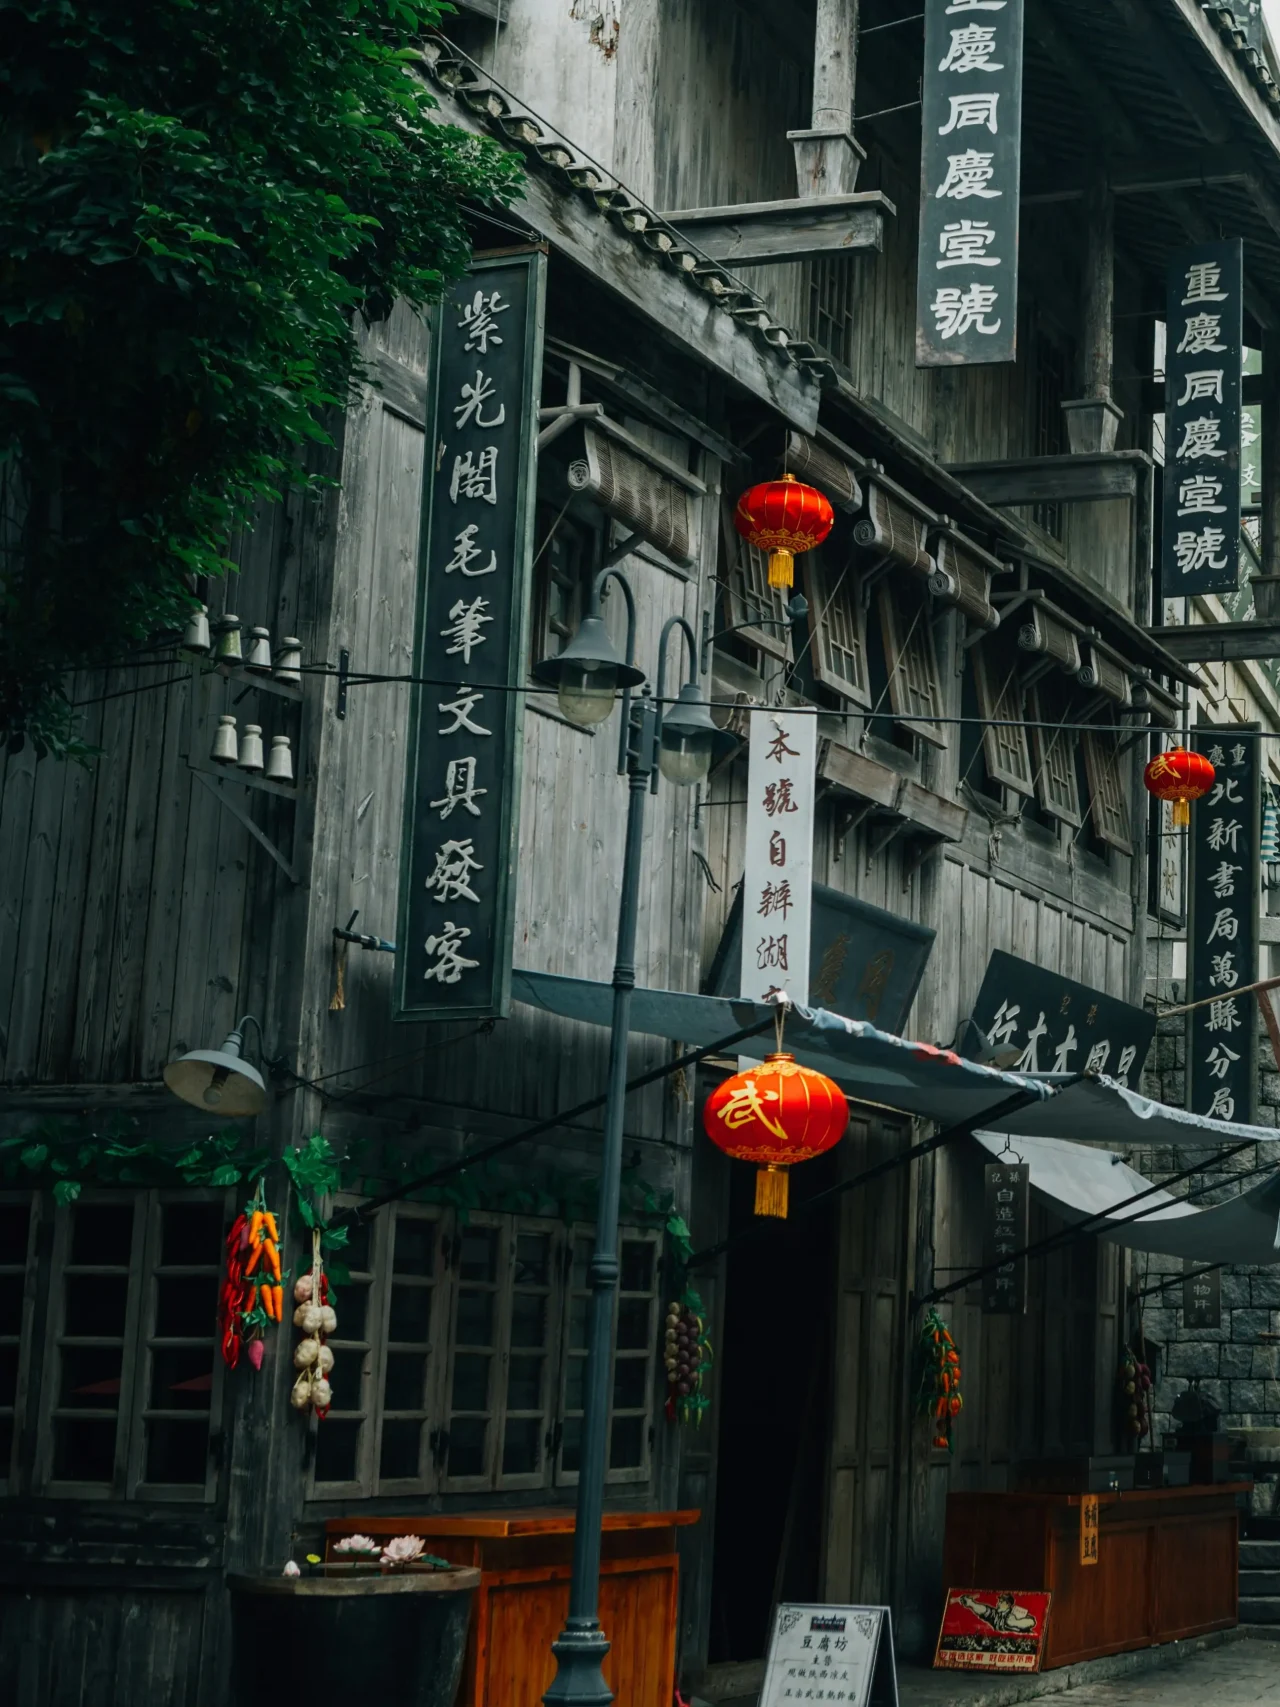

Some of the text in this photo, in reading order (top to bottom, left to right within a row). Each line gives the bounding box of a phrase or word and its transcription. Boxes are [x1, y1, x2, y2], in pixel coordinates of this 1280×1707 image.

[1173, 261, 1229, 574] 重慶同慶堂號
[1204, 777, 1244, 1122] 北新書局萬縣分局
[800, 1634, 848, 1652] 豆腐坊
